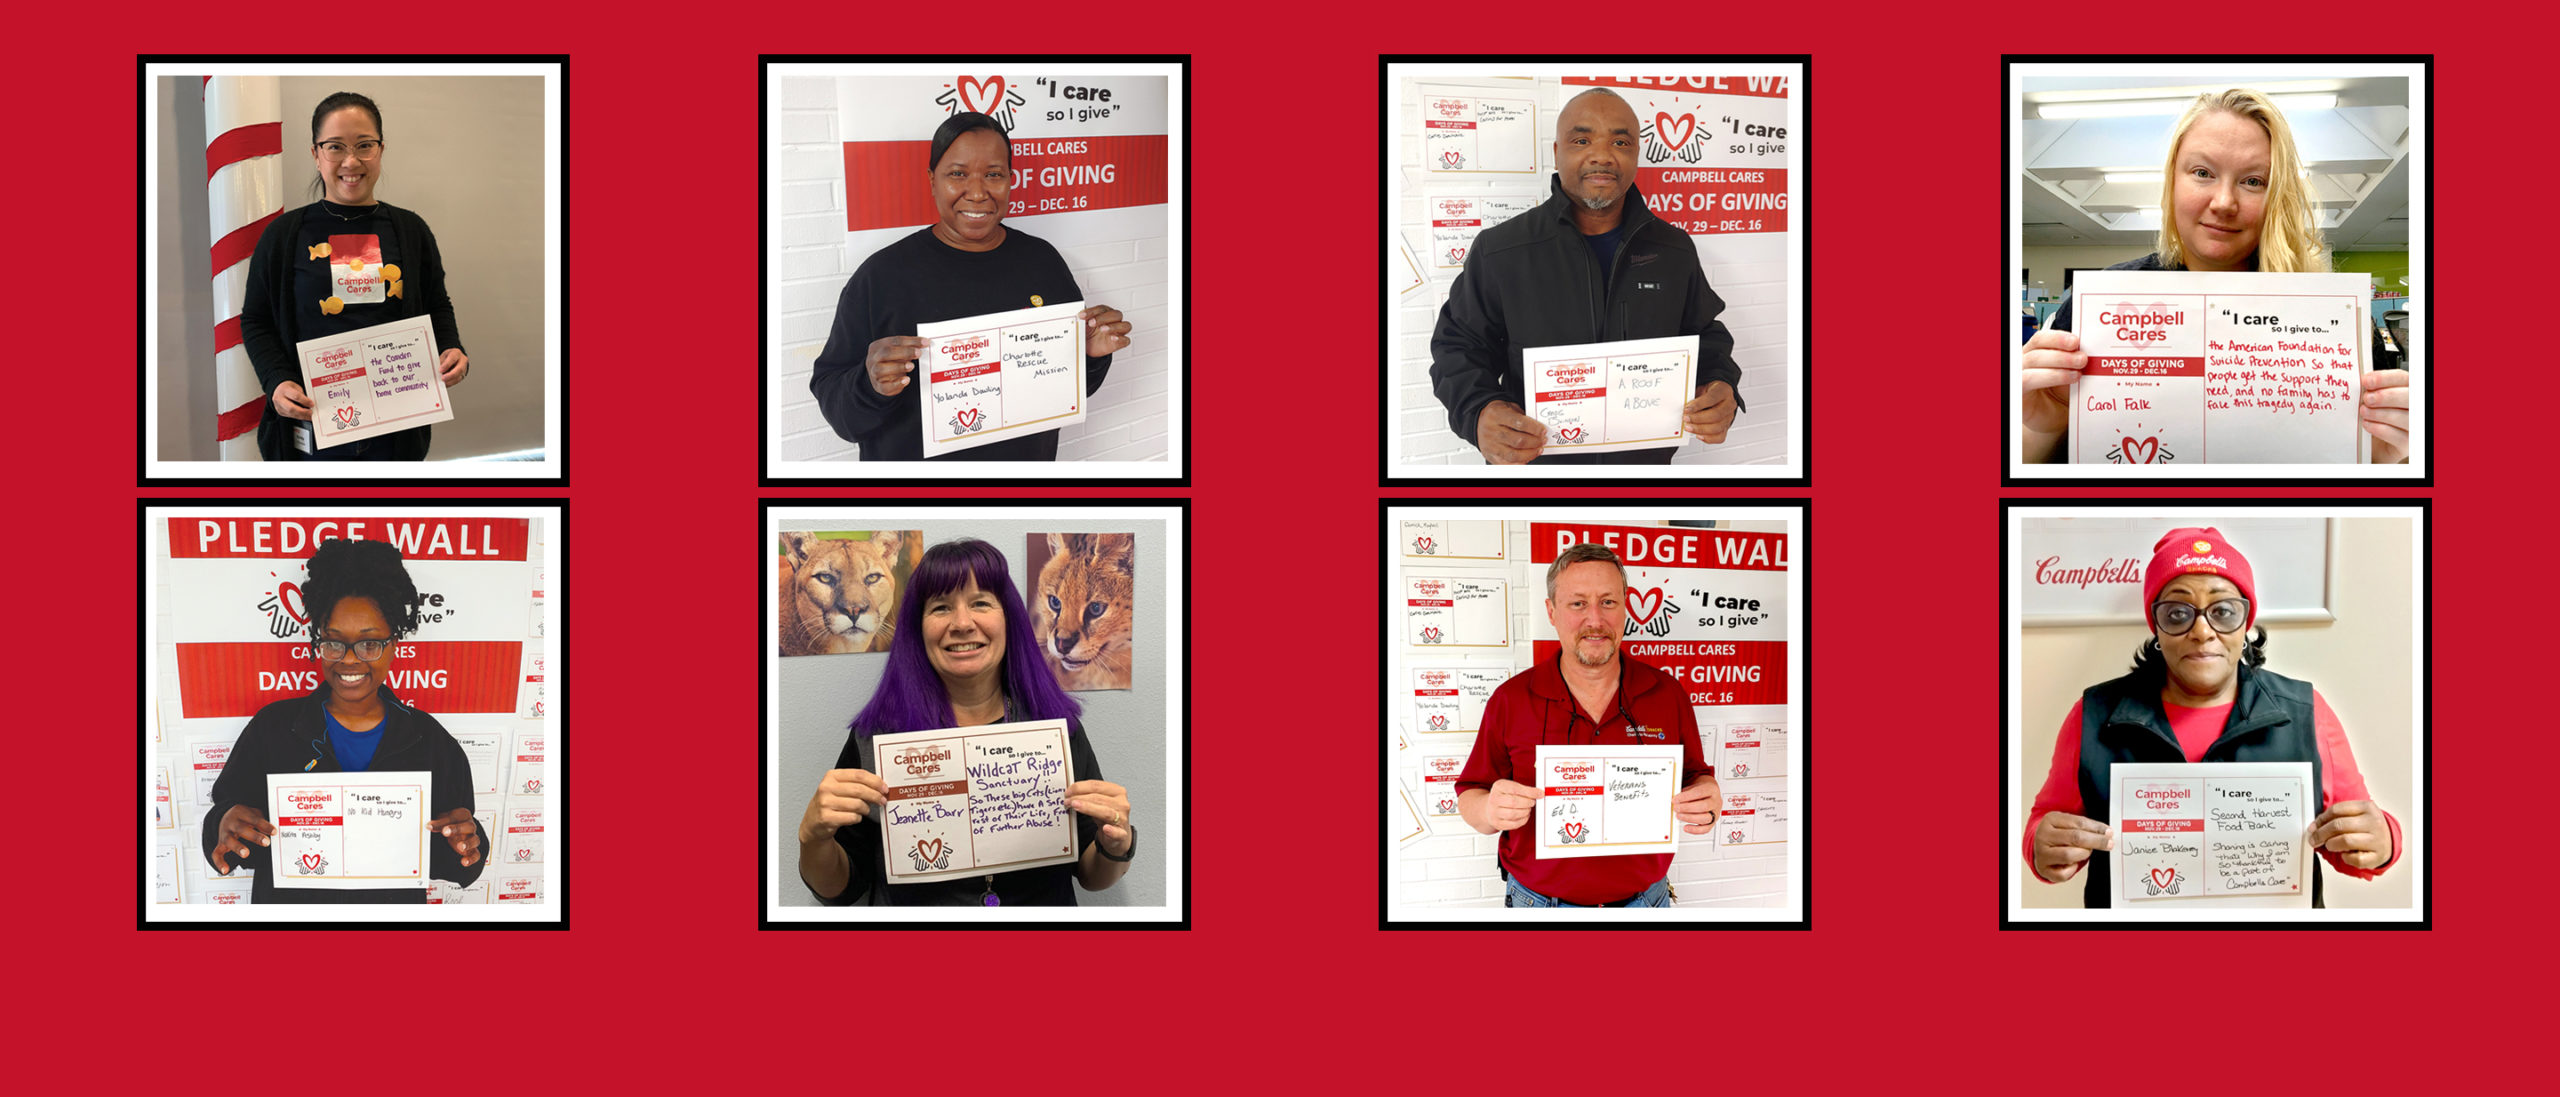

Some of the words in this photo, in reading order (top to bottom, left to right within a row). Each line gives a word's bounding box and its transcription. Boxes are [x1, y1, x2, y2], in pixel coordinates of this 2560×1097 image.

[1036, 77, 1056, 98] "I
[1064, 85, 1111, 102] care
[1046, 109, 1064, 121] so
[1069, 107, 1073, 120] I
[1722, 116, 1739, 133] "I
[1745, 124, 1787, 139] care
[1047, 141, 1087, 155] CARES
[1730, 144, 1745, 153] so
[1750, 143, 1752, 153] I
[1757, 142, 1785, 155] give
[1040, 164, 1115, 187] GIVING
[1662, 171, 1726, 183] CAMPBELL
[1729, 172, 1764, 183] CARES
[1009, 201, 1025, 213] 29
[1040, 198, 1068, 211] DEC.
[1072, 196, 1087, 208] 16
[1689, 193, 1716, 212] OF
[1722, 193, 1787, 211] GIVING
[1693, 221, 1708, 232] 29
[1720, 221, 1745, 231] DEC.
[1748, 219, 1761, 230] 16
[337, 277, 380, 286] Campbell
[2100, 311, 2183, 328] Campbell
[2243, 315, 2279, 325] care
[2117, 328, 2166, 340] Cares
[2290, 325, 2310, 334] give
[1020, 333, 1039, 341] care
[941, 339, 989, 354] Campbell
[2208, 340, 2223, 351] the
[2228, 340, 2273, 352] American
[2278, 341, 2334, 354] Foundation
[2338, 343, 2352, 355] for
[316, 350, 353, 363] Campbell
[371, 358, 382, 366] the
[952, 351, 980, 361] Cares
[2210, 355, 2245, 366] Suicide
[2249, 355, 2306, 368] Prevention
[2331, 359, 2353, 370] that
[325, 360, 347, 368] Cares
[379, 365, 394, 374] Fund
[407, 362, 421, 372] give
[2148, 360, 2184, 368] GIVING
[1033, 366, 1068, 379] Mission
[1546, 366, 1595, 377] Campbell
[373, 378, 388, 387] back
[1557, 376, 1586, 384] Cares
[1619, 378, 1626, 389] A
[1632, 377, 1662, 390] ROOF
[2208, 371, 2238, 383] people
[2241, 370, 2256, 386] get
[2261, 371, 2278, 381] the
[2325, 374, 2349, 394] they
[328, 388, 350, 399] Emily
[395, 382, 428, 393] community
[2236, 386, 2254, 396] and
[2261, 387, 2273, 396] no
[2277, 385, 2312, 402] family
[2318, 388, 2335, 399] has
[2341, 392, 2350, 400] to
[1624, 397, 1661, 409] ABOVE
[2087, 396, 2117, 411] Carol
[2124, 398, 2151, 410] Falk
[2234, 398, 2253, 407] this
[2257, 399, 2295, 414] tragedy
[2300, 402, 2336, 415] again.
[386, 522, 499, 555] WALL
[2035, 555, 2142, 590] Campbell's
[1690, 589, 1708, 607] "I
[1714, 596, 1760, 611] care
[1699, 616, 1715, 627] so
[1720, 615, 1723, 626] I
[1630, 645, 1695, 656] CAMPBELL
[1698, 644, 1735, 656] CARES
[1691, 666, 1761, 683] GIVING
[258, 671, 318, 692] DAYS
[1690, 693, 1715, 703] DEC.
[1720, 692, 1733, 702] 16
[894, 750, 951, 765] Campbell
[990, 747, 1012, 755] care
[907, 764, 940, 774] Cares
[1027, 757, 1062, 774] Ridge
[1554, 765, 1595, 773] Campbell
[976, 774, 1040, 791] Sanctuary
[288, 794, 332, 803] Campbell
[984, 793, 1010, 802] These
[1012, 791, 1025, 801] big
[2136, 789, 2190, 800] Campbell
[1552, 804, 1565, 817] Ed
[2147, 800, 2179, 809] Cares
[378, 808, 402, 819] Hungry
[888, 805, 934, 825] Jeanette
[932, 803, 964, 818] Barr
[970, 806, 996, 818] Tigers
[2211, 808, 2246, 820] Second
[2252, 806, 2292, 818] Harvest
[973, 816, 989, 824] rest
[2217, 821, 2243, 831] Food
[2244, 820, 2276, 830] Bank
[2122, 841, 2158, 856] Janice
